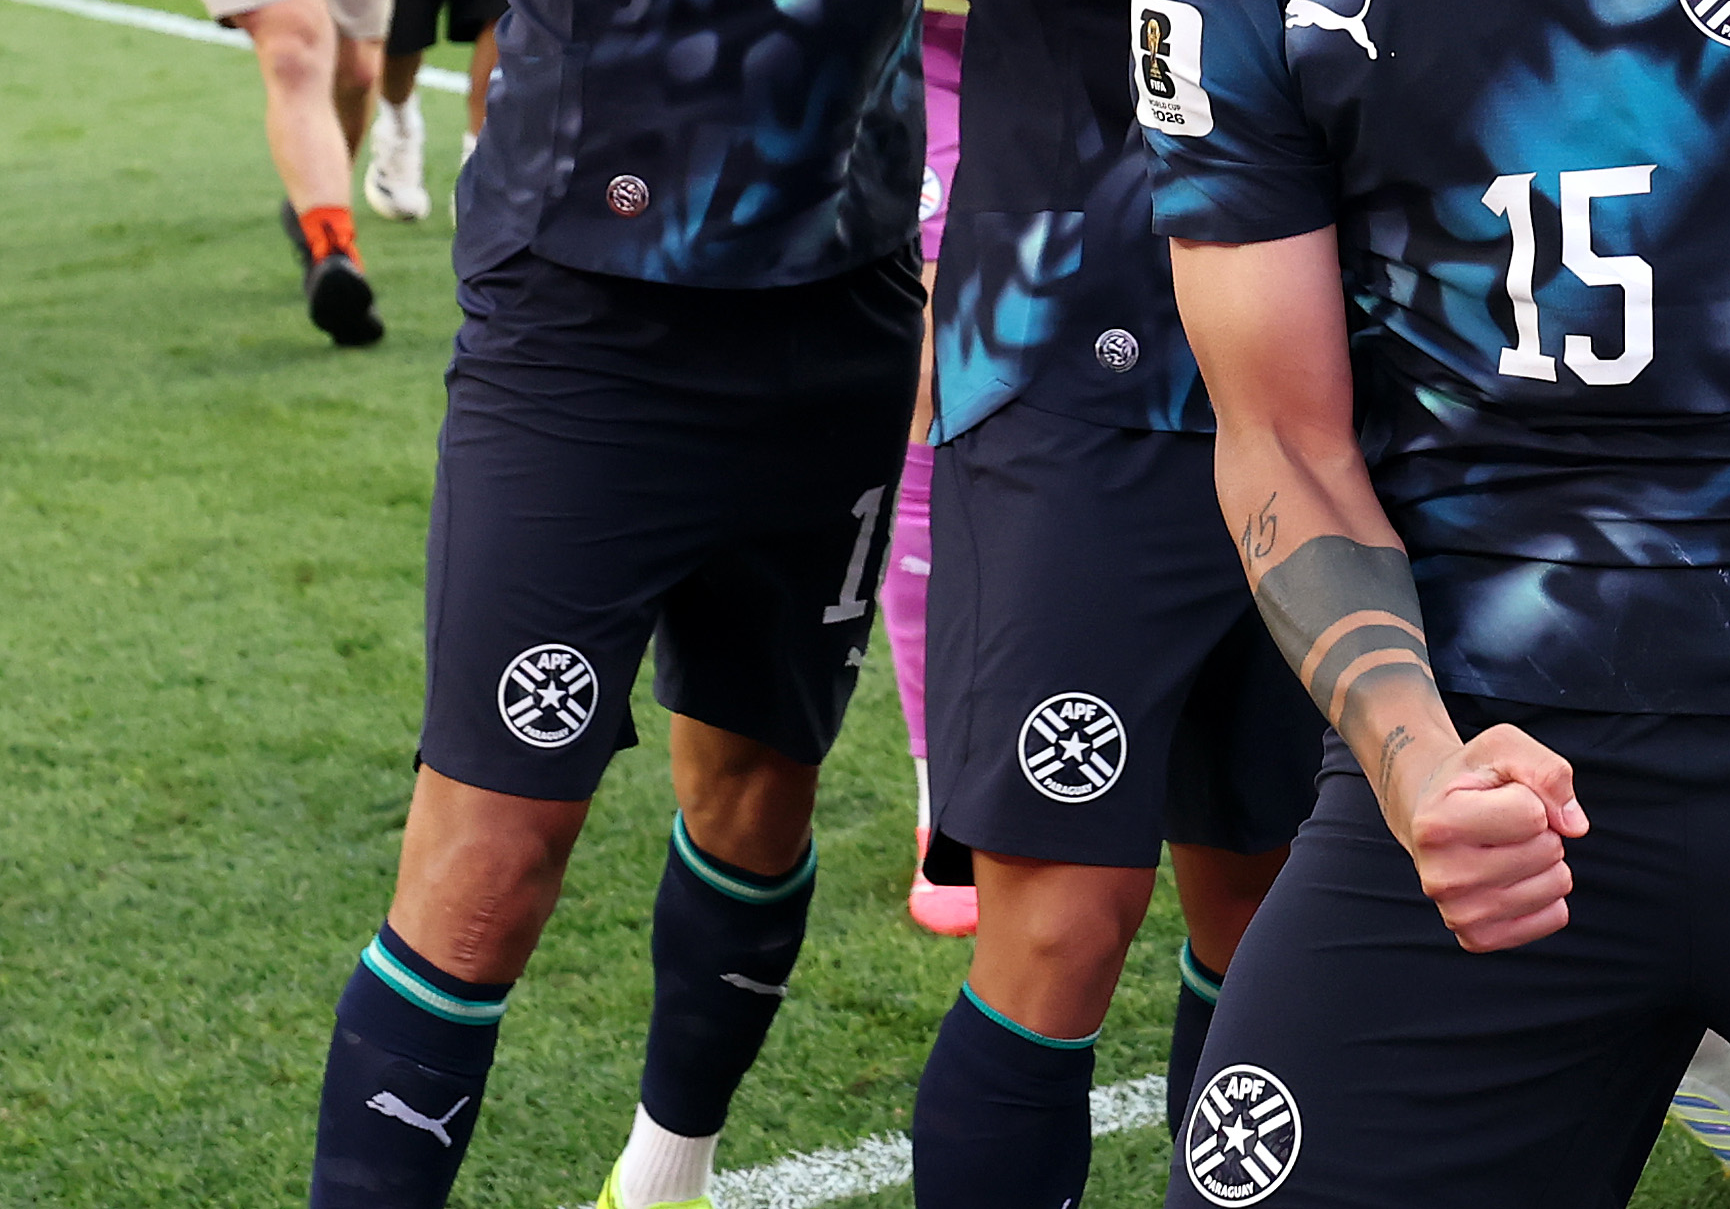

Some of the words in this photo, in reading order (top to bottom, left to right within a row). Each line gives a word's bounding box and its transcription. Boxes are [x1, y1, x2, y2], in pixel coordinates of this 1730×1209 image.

[1481, 164, 1658, 386] 15
[1241, 491, 1277, 571] 15
[536, 652, 572, 670] APF
[1059, 701, 1098, 722] APF
[1043, 777, 1092, 795] PARAGUAY
[1224, 1076, 1266, 1102] APF
[1203, 1174, 1254, 1198] PARAGUAY
